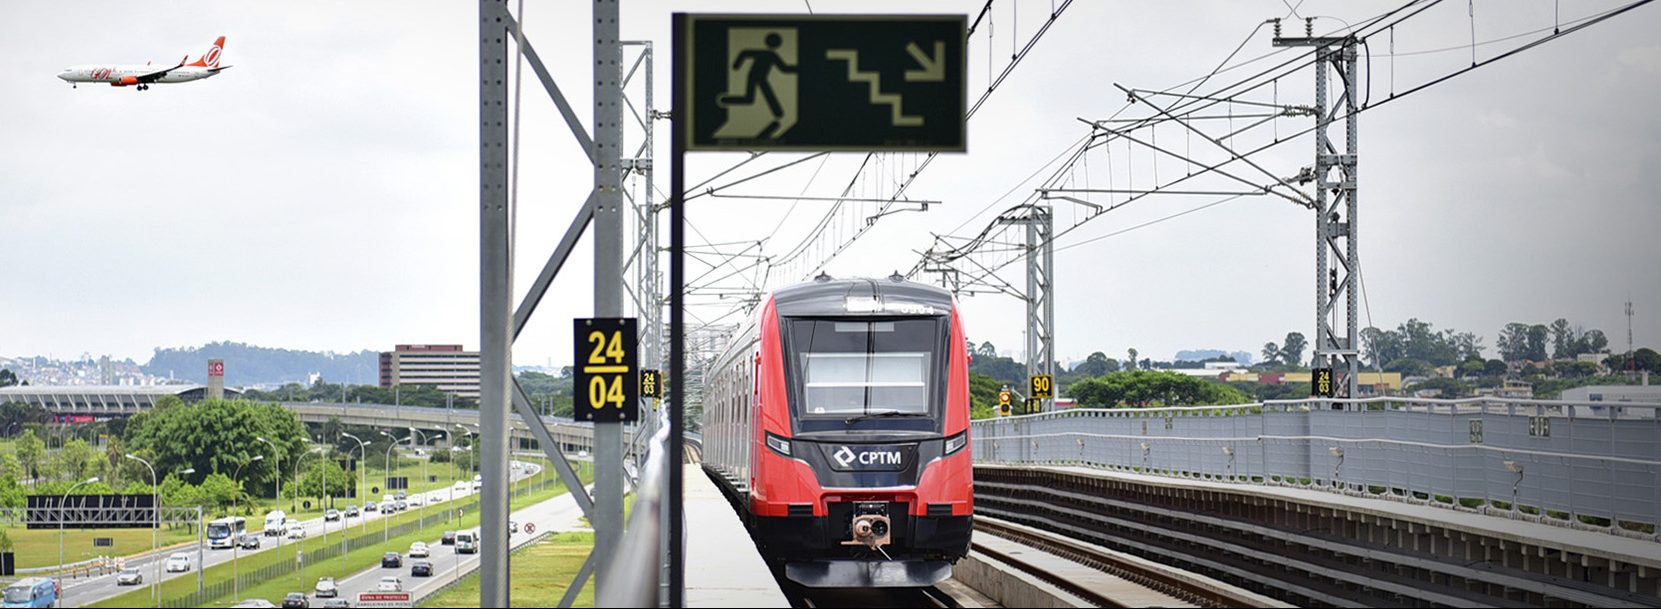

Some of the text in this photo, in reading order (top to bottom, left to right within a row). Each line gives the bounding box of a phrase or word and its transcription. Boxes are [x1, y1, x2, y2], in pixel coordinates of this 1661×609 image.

[588, 330, 625, 363] 24
[644, 372, 655, 382] 24
[1319, 371, 1329, 380] 24
[644, 385, 655, 394] 03
[1033, 377, 1049, 392] 90
[1319, 383, 1329, 393] 03
[588, 375, 626, 409] 04
[859, 451, 901, 465] CPTM
